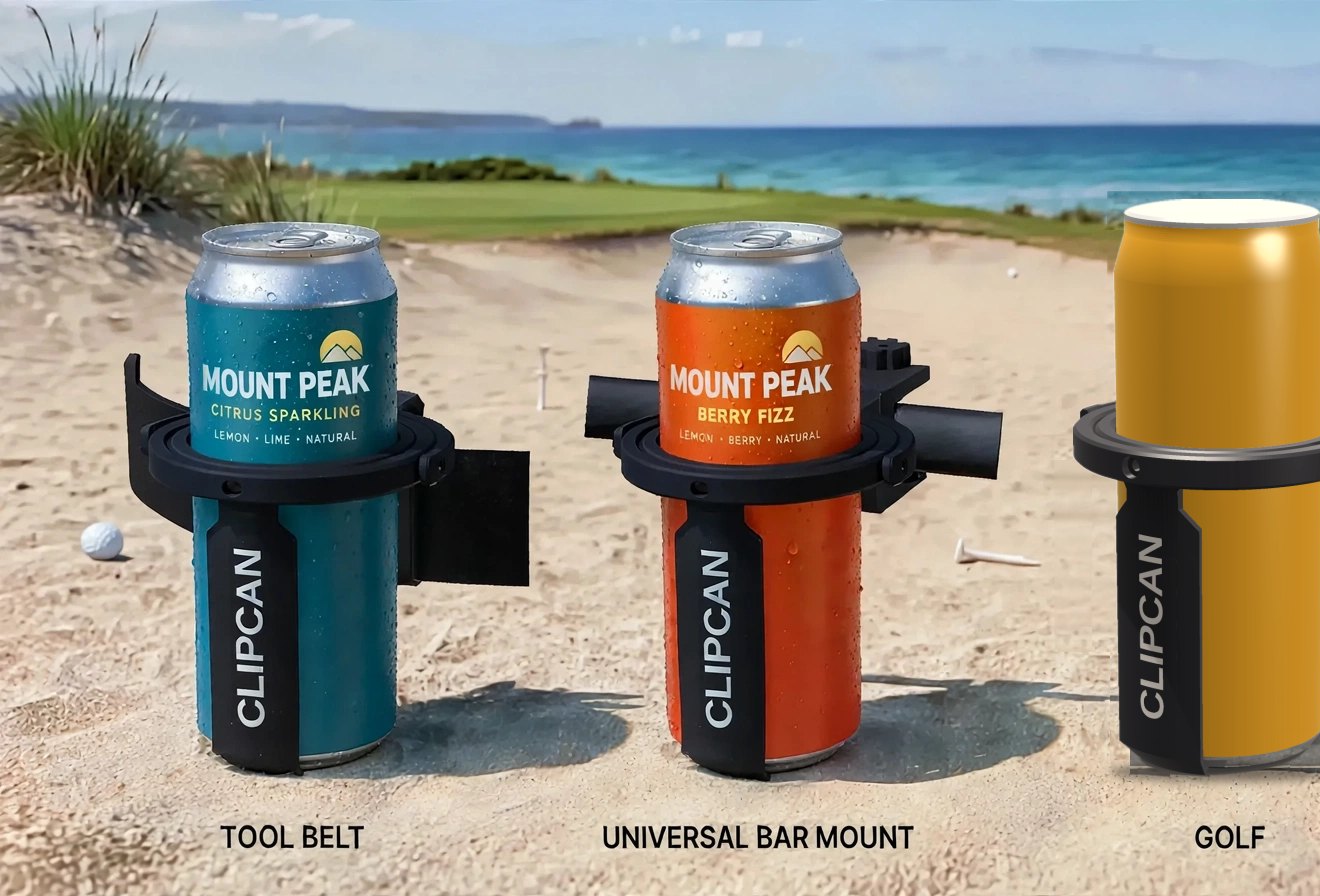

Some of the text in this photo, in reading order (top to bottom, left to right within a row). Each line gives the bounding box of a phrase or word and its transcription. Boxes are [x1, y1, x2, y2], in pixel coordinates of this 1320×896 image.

[202, 363, 370, 400] MOUNT PEAK
[670, 363, 832, 399] MOUNT PEAK
[211, 403, 360, 422] CITRUS SPARKLING
[697, 406, 795, 425] BERRY FIZZ
[214, 429, 357, 445] LEMON LIME NATURAL
[679, 429, 821, 445] LEMON BERRY NATURAL
[232, 547, 266, 728] CLIPCAN
[700, 549, 733, 729] CLIPCAN
[1138, 533, 1165, 720] CLIPCAN
